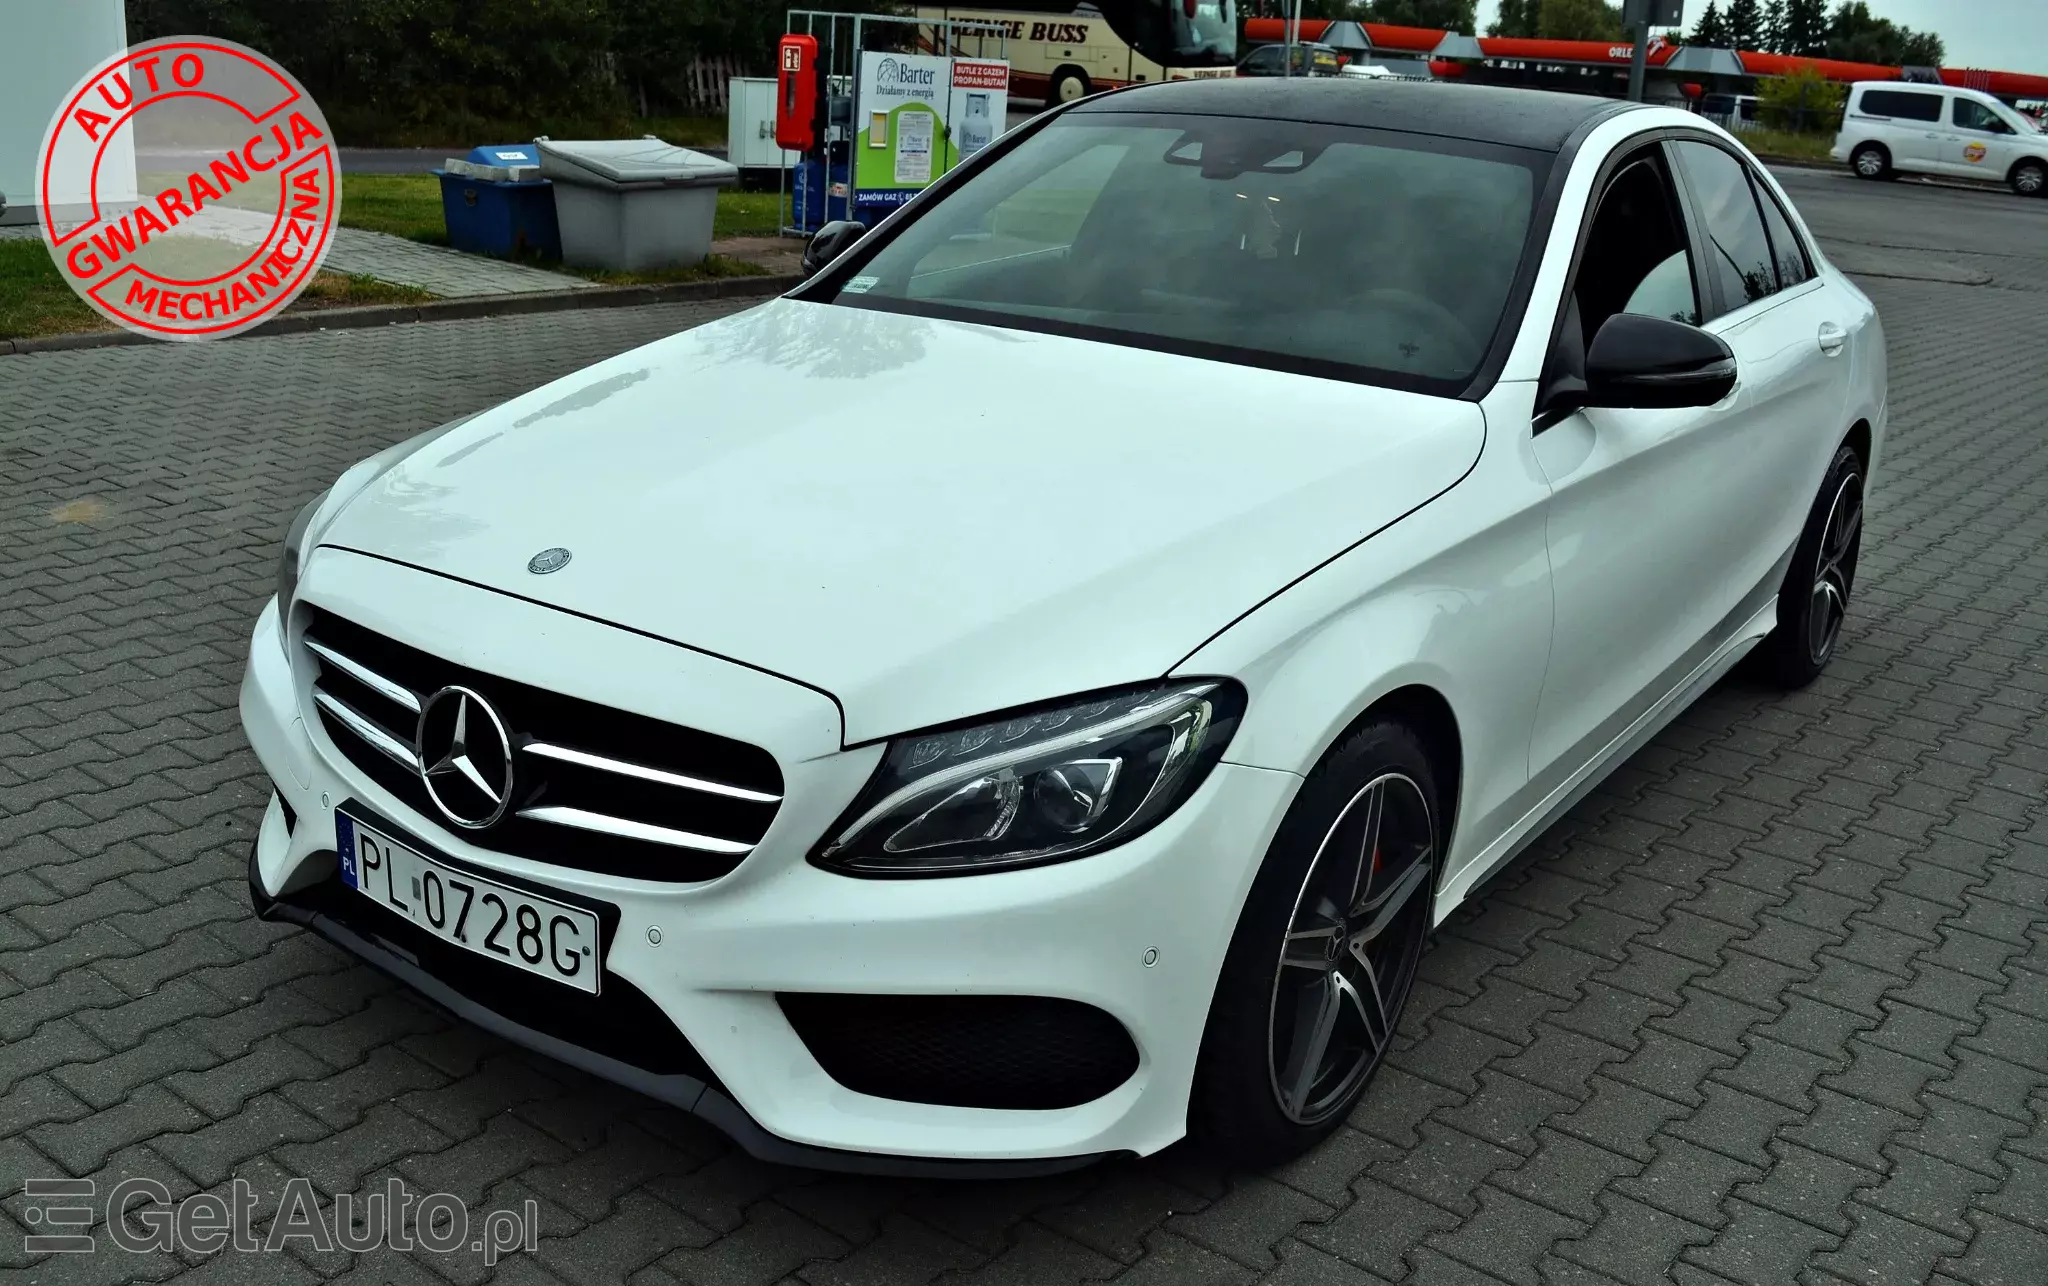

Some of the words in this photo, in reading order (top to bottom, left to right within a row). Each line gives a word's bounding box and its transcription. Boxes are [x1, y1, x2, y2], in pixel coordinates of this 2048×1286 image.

[1029, 22, 1089, 44] BUSS
[1608, 46, 1634, 58] ORLE
[900, 63, 935, 85] Barter
[956, 65, 977, 74] BUTLE
[977, 67, 982, 75] Z
[983, 67, 1005, 76] GAZEM
[953, 76, 1007, 86] PROPAN-BUTAN
[876, 85, 906, 98] Działamy
[912, 88, 934, 100] energią
[858, 192, 883, 201] ZAMÓW
[884, 193, 897, 201] GAZ
[342, 858, 355, 876] PL
[360, 833, 408, 912] PL
[423, 870, 581, 977] 0728G
